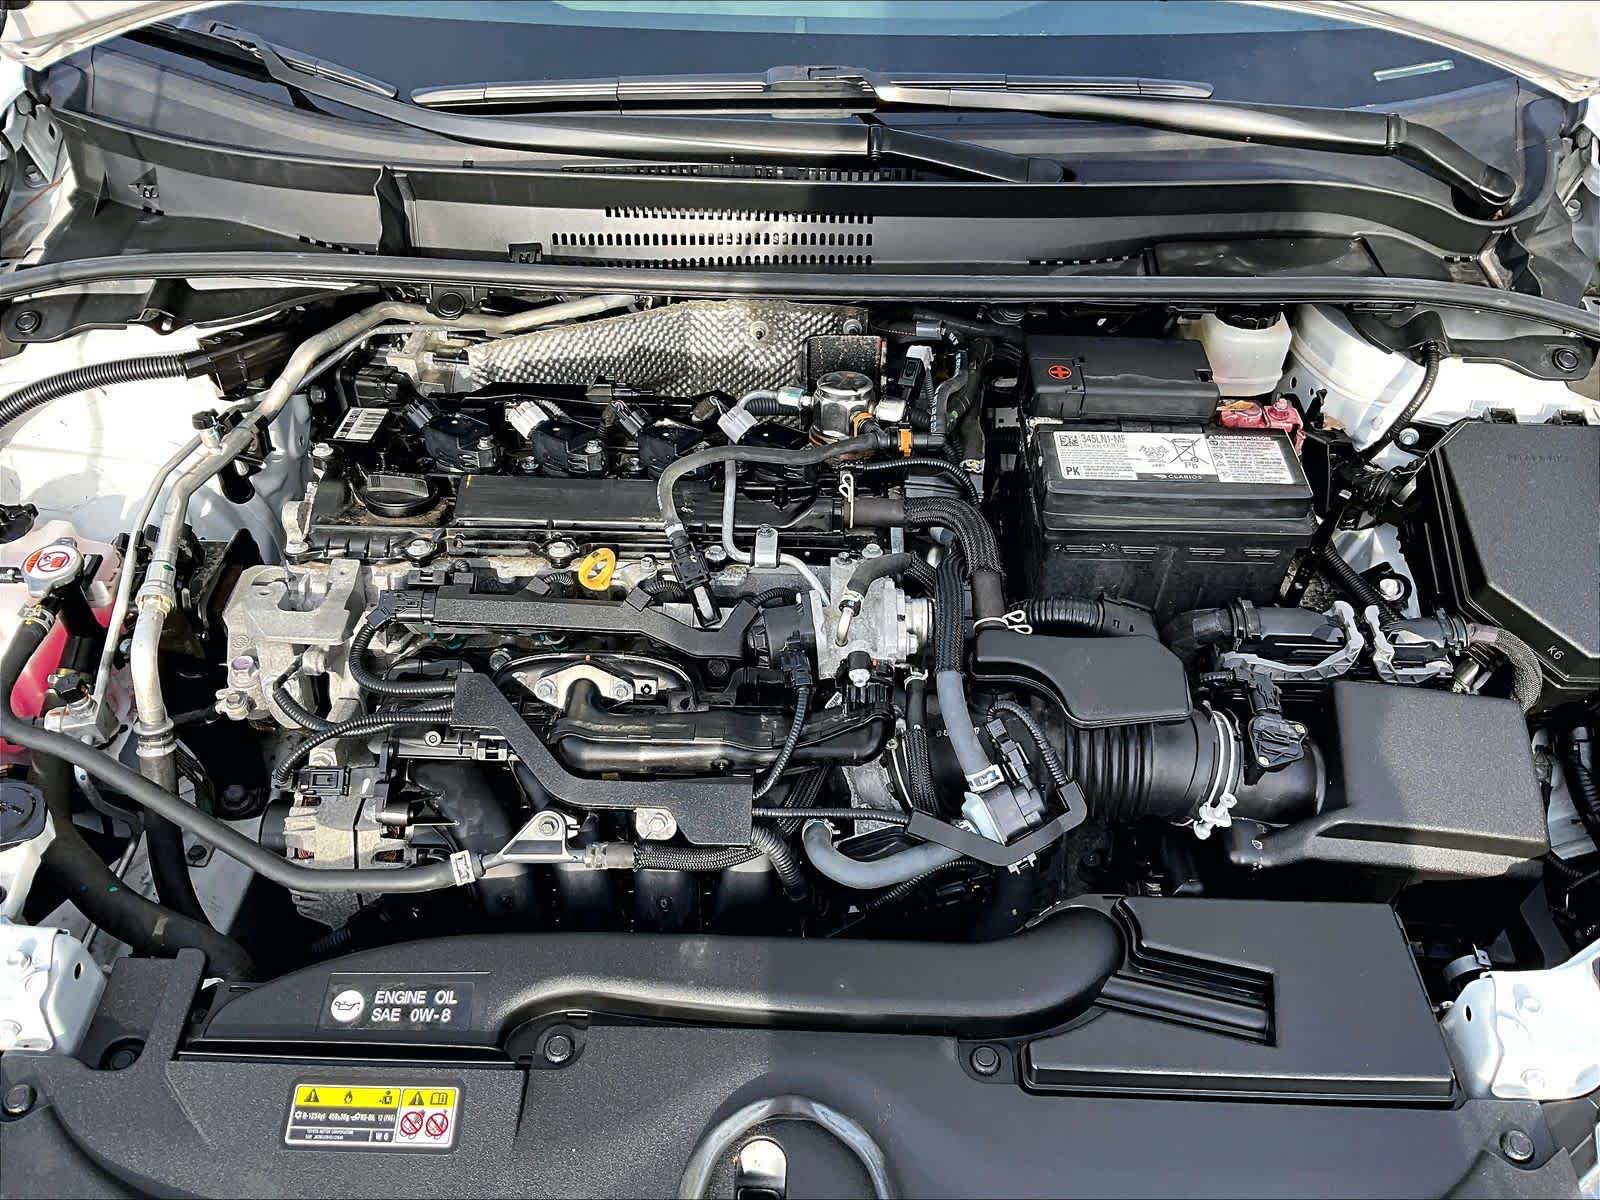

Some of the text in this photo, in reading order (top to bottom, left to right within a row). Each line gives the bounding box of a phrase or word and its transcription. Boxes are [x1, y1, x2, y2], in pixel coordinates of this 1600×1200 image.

[1065, 466, 1081, 476] PK
[1168, 473, 1203, 481] CLARIOS
[1546, 645, 1565, 660] K6
[374, 989, 458, 1005] ENGINE OIL
[371, 1007, 452, 1022] SAE 0W-8
